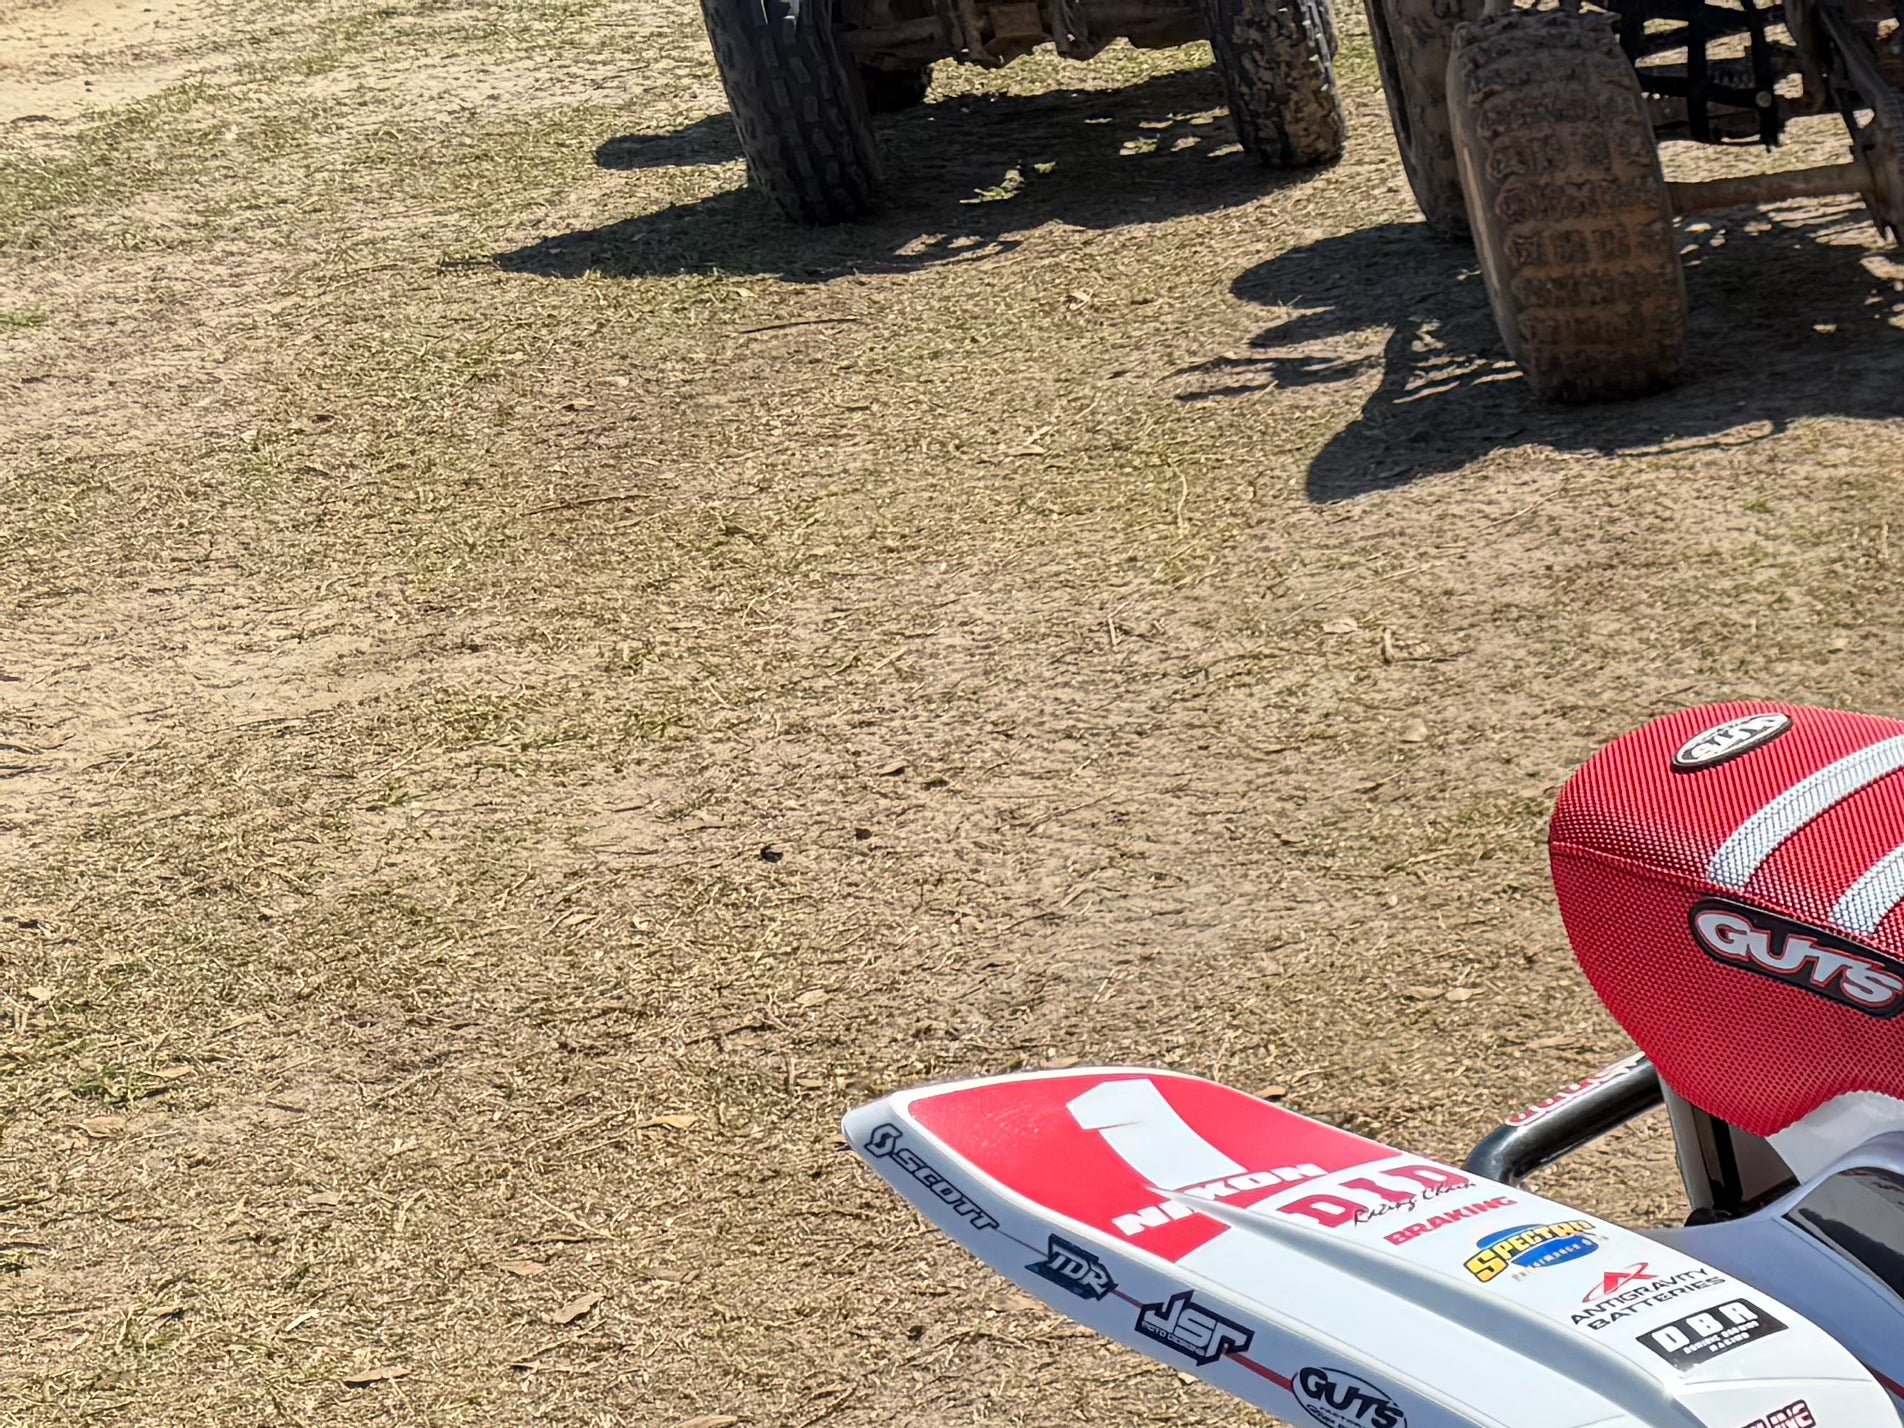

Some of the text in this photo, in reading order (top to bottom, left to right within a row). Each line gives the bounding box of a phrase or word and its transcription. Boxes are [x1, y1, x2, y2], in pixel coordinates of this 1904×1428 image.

[1065, 1077, 1250, 1193] 1
[892, 1145, 1000, 1232] SCOTT
[1383, 1195, 1519, 1246] BRAKING
[1048, 1248, 1114, 1295] TDR
[1463, 1219, 1596, 1284] SPECTRO
[1570, 1267, 1711, 1326] ANTIGRAVITY
[1587, 1275, 1727, 1331] BATTERIES
